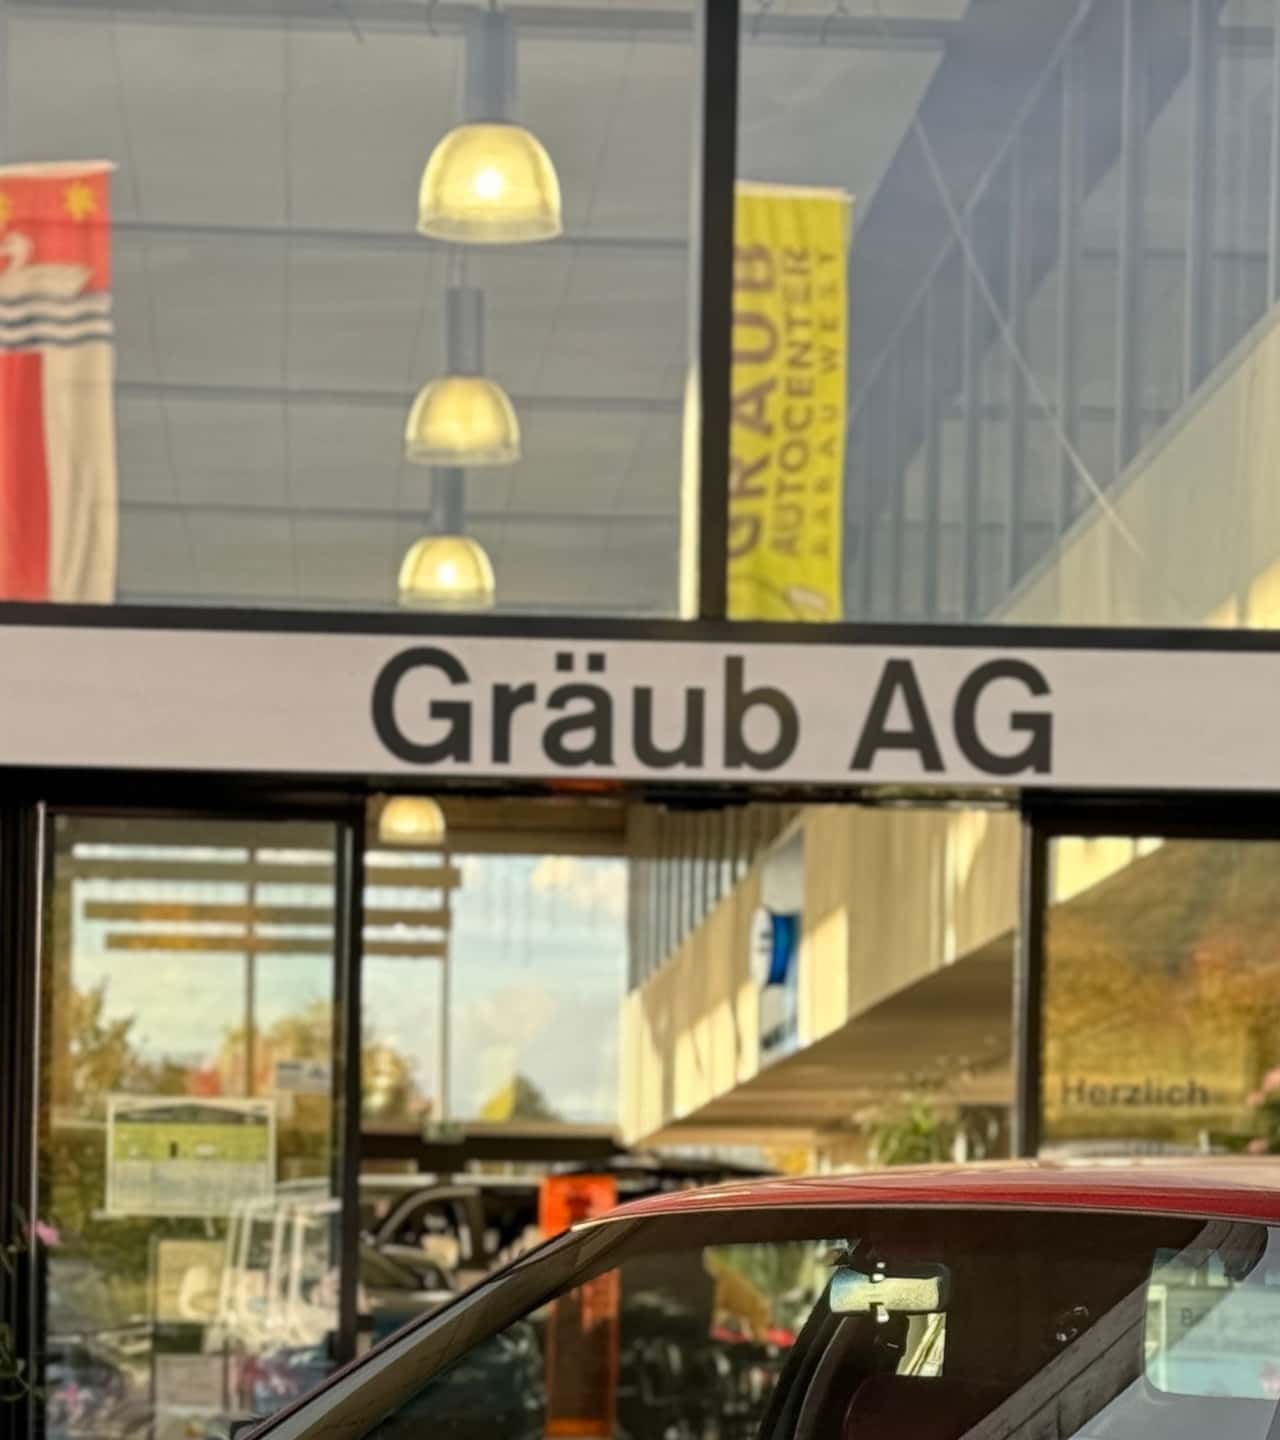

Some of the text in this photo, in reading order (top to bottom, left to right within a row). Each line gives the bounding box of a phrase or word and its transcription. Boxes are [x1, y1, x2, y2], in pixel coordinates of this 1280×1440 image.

[771, 246, 814, 557] AUTOCENTER
[371, 645, 1054, 776] Gräub AG
[1061, 1076, 1209, 1106] Herzlich
